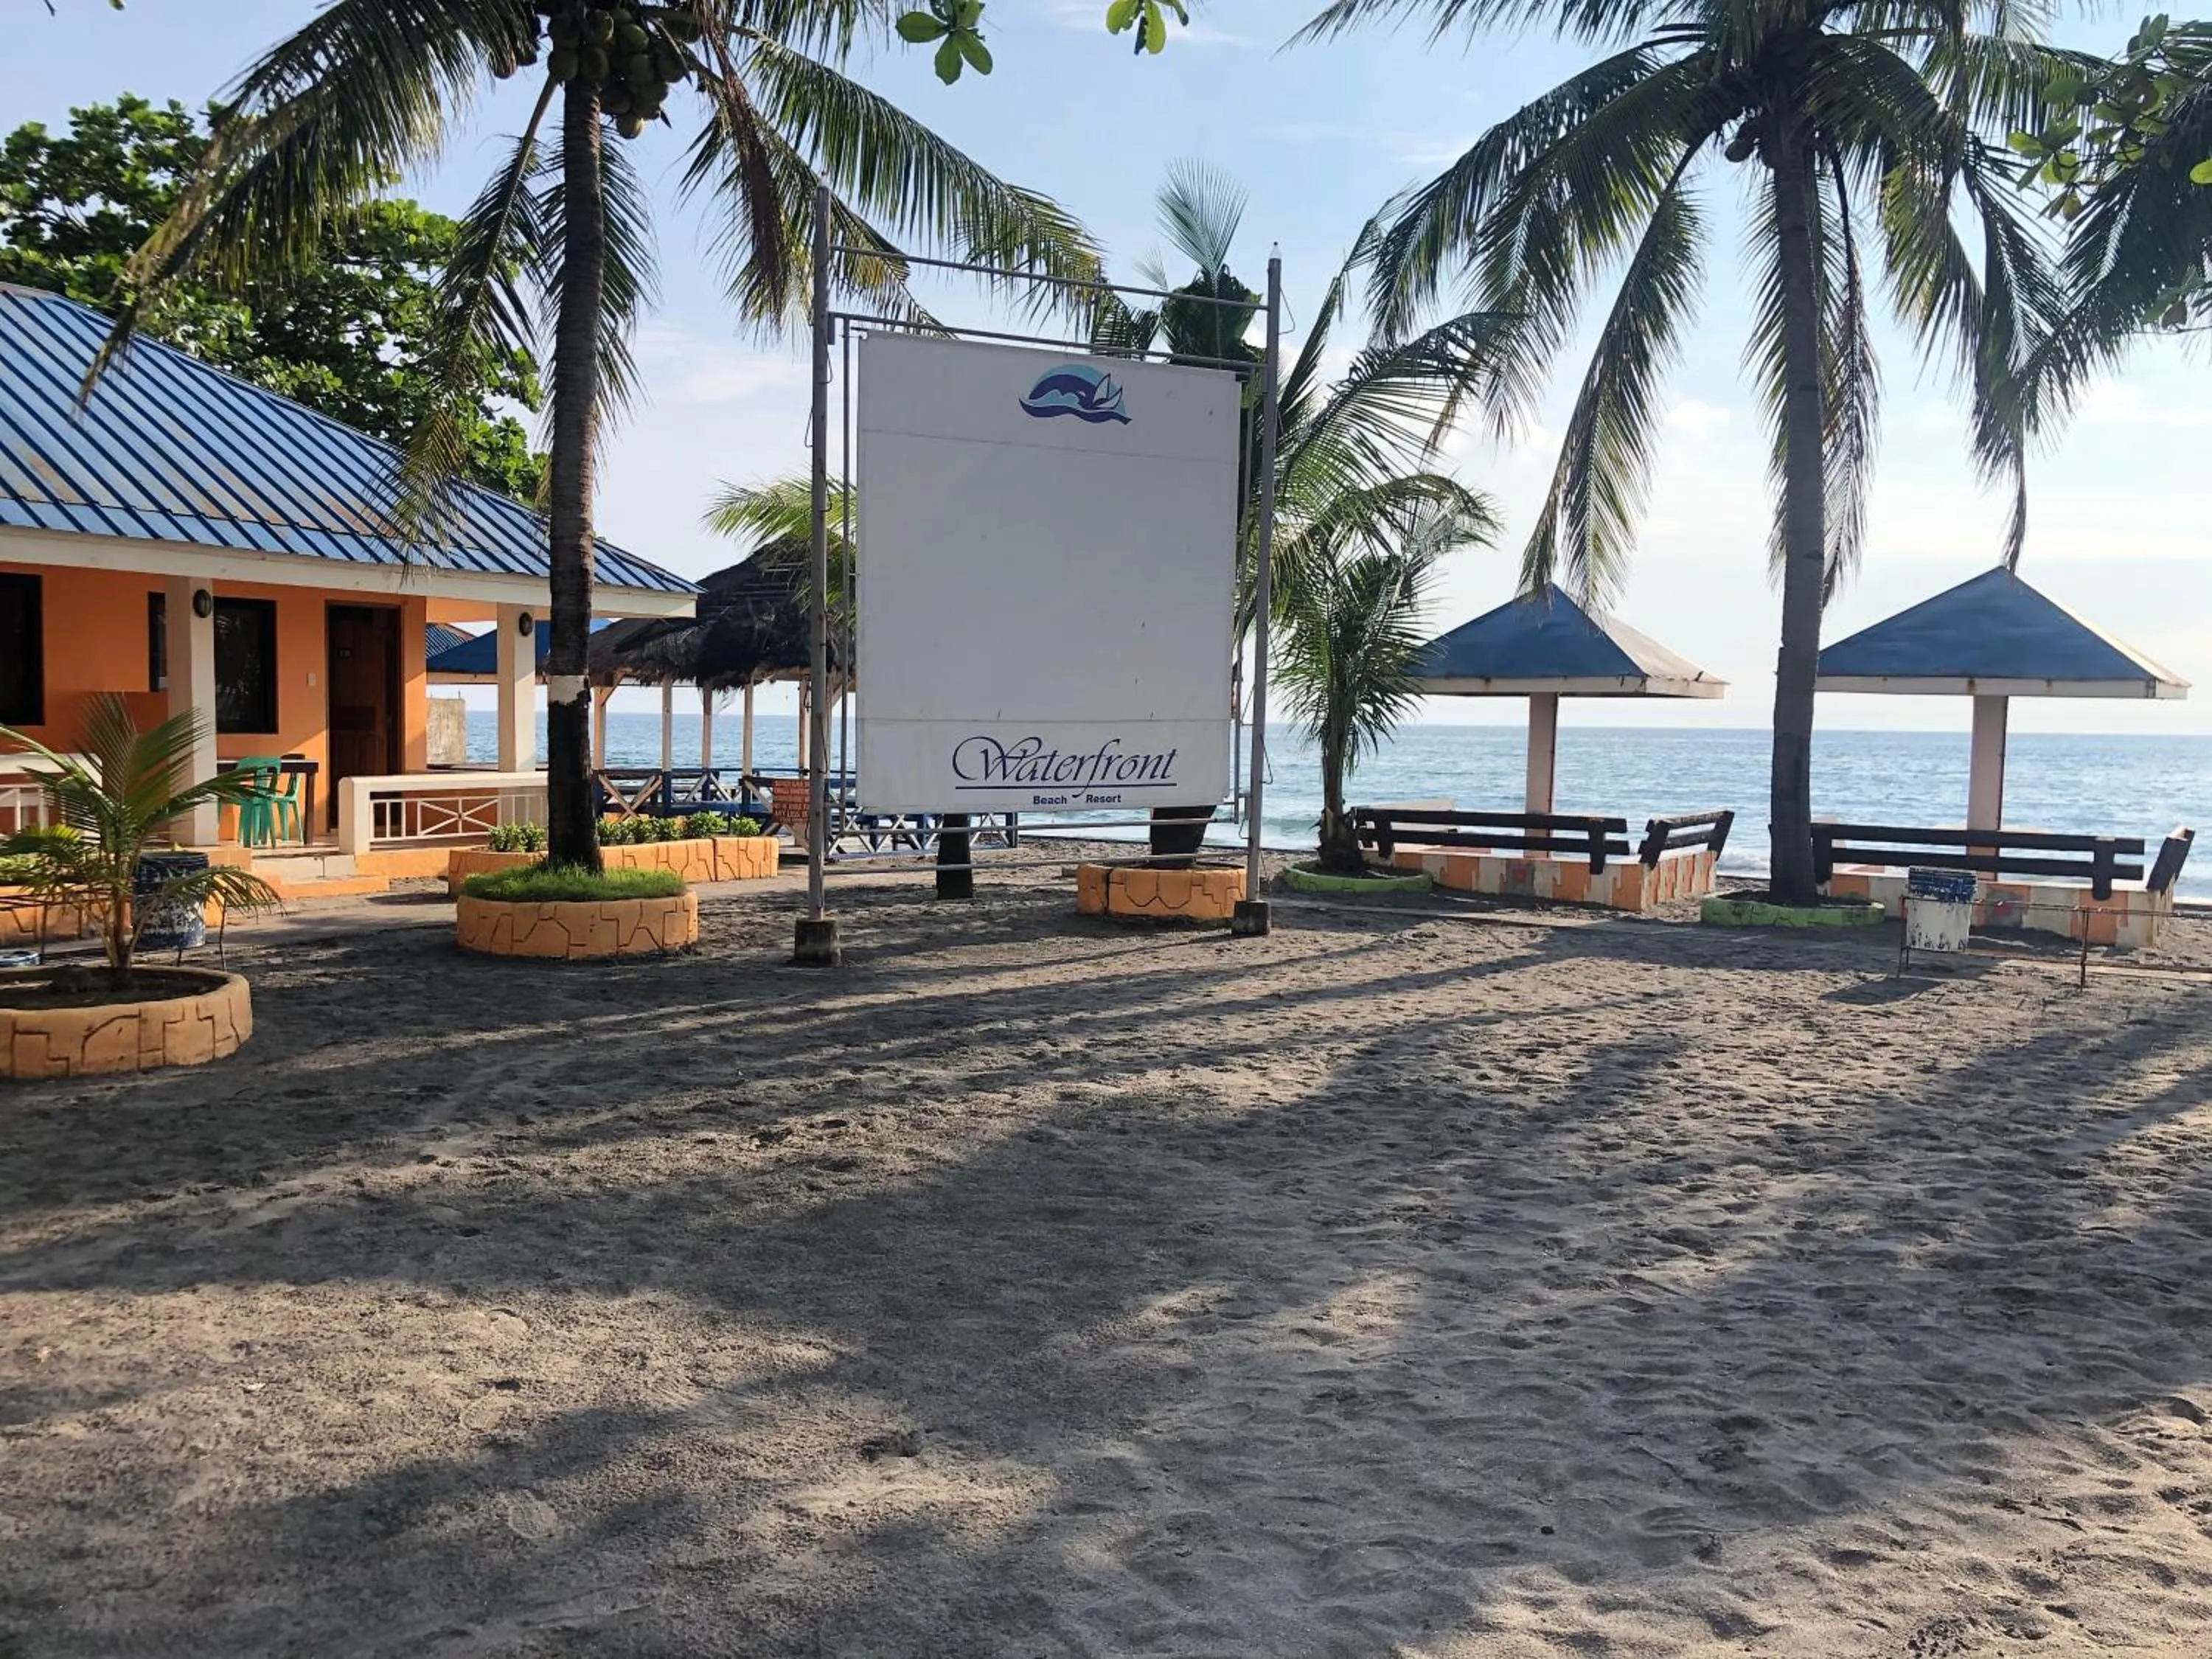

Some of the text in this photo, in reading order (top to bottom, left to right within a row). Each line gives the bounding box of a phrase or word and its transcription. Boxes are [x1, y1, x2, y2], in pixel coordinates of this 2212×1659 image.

[952, 736, 1178, 798] Waterfront
[1033, 794, 1121, 804] Beach Resort
